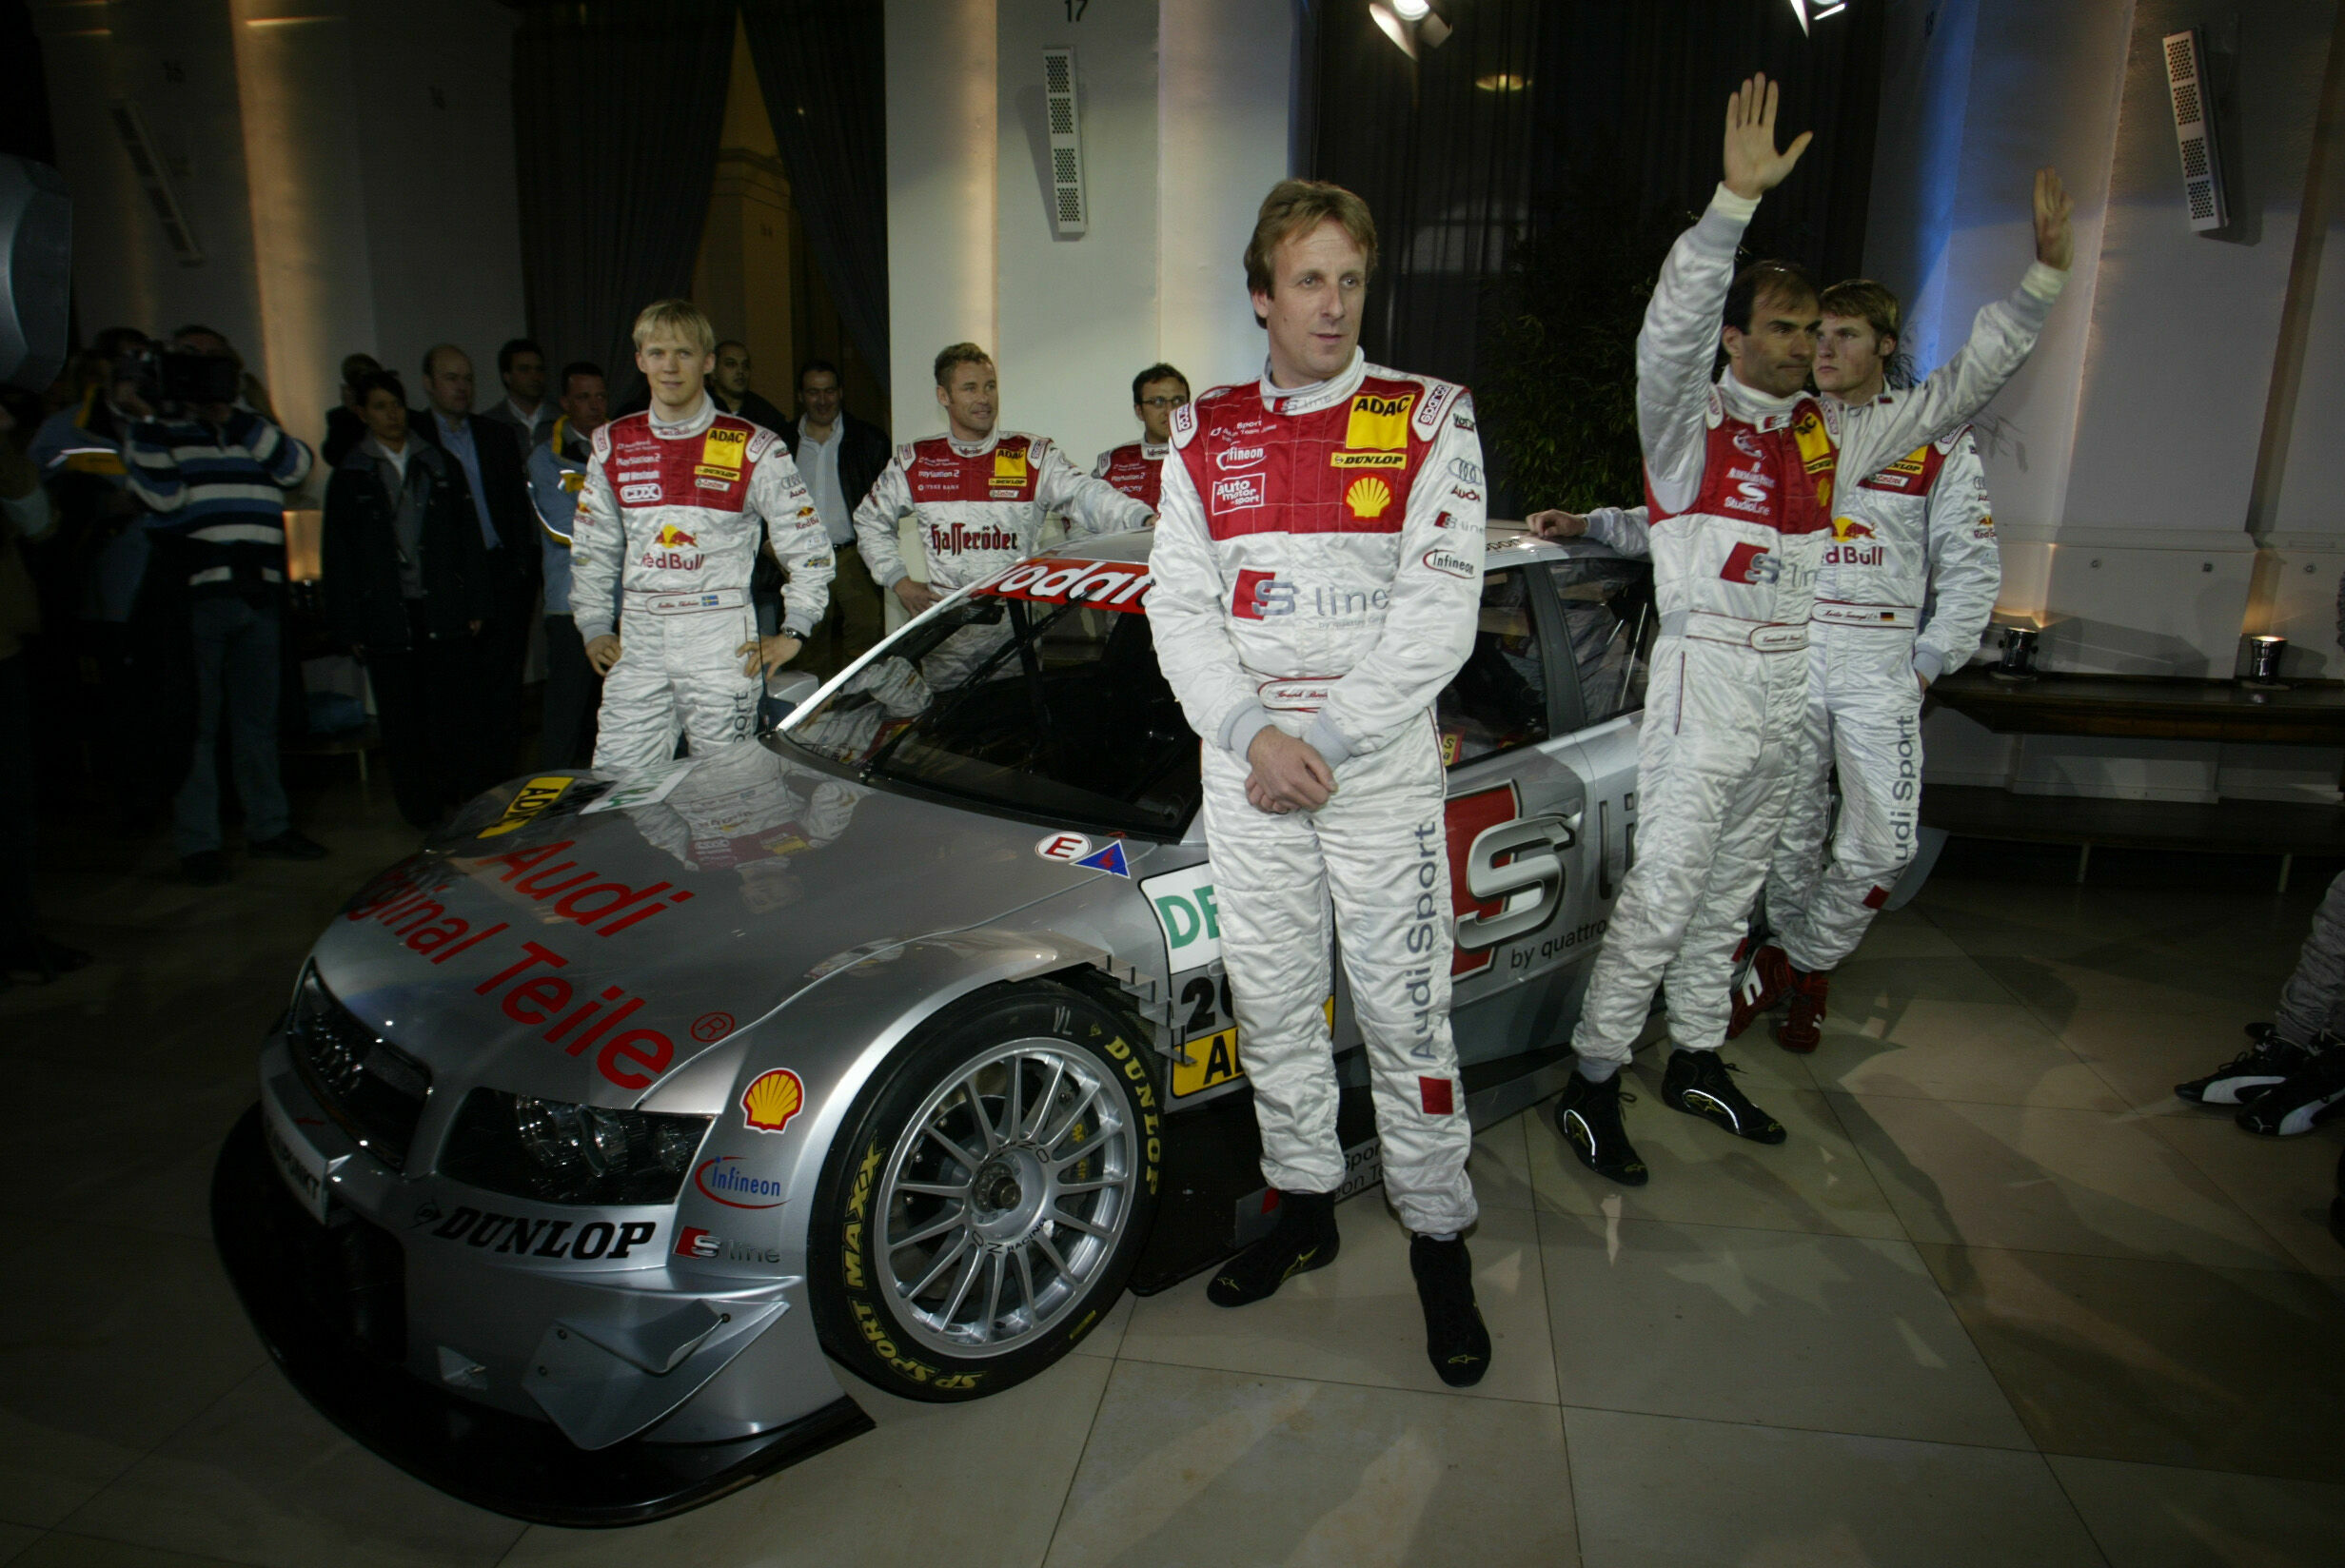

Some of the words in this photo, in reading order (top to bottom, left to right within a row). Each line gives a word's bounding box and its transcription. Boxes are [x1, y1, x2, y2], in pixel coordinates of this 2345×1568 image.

[1353, 397, 1410, 417] ADAC
[709, 429, 744, 443] ADAC
[1344, 455, 1404, 466] DUNLOP
[669, 552, 705, 571] Bull
[1843, 545, 1883, 567] Bull
[1251, 578, 1300, 617] S
[1315, 584, 1390, 617] line
[1891, 715, 1917, 802] Sport
[1044, 836, 1083, 858] E
[475, 840, 696, 938] Audi
[1406, 820, 1437, 954] Sport
[1455, 812, 1576, 951] S
[1509, 946, 1536, 970] by
[1541, 919, 1607, 963] quattro
[474, 940, 675, 1090] Teile
[1406, 965, 1437, 1062] Audi
[1104, 1035, 1161, 1196] DUNLOP
[711, 1156, 781, 1198] Infineon
[432, 1205, 658, 1262] DUNLOP
[1007, 1217, 1048, 1253] RACING
[847, 1297, 940, 1383] SPORT
